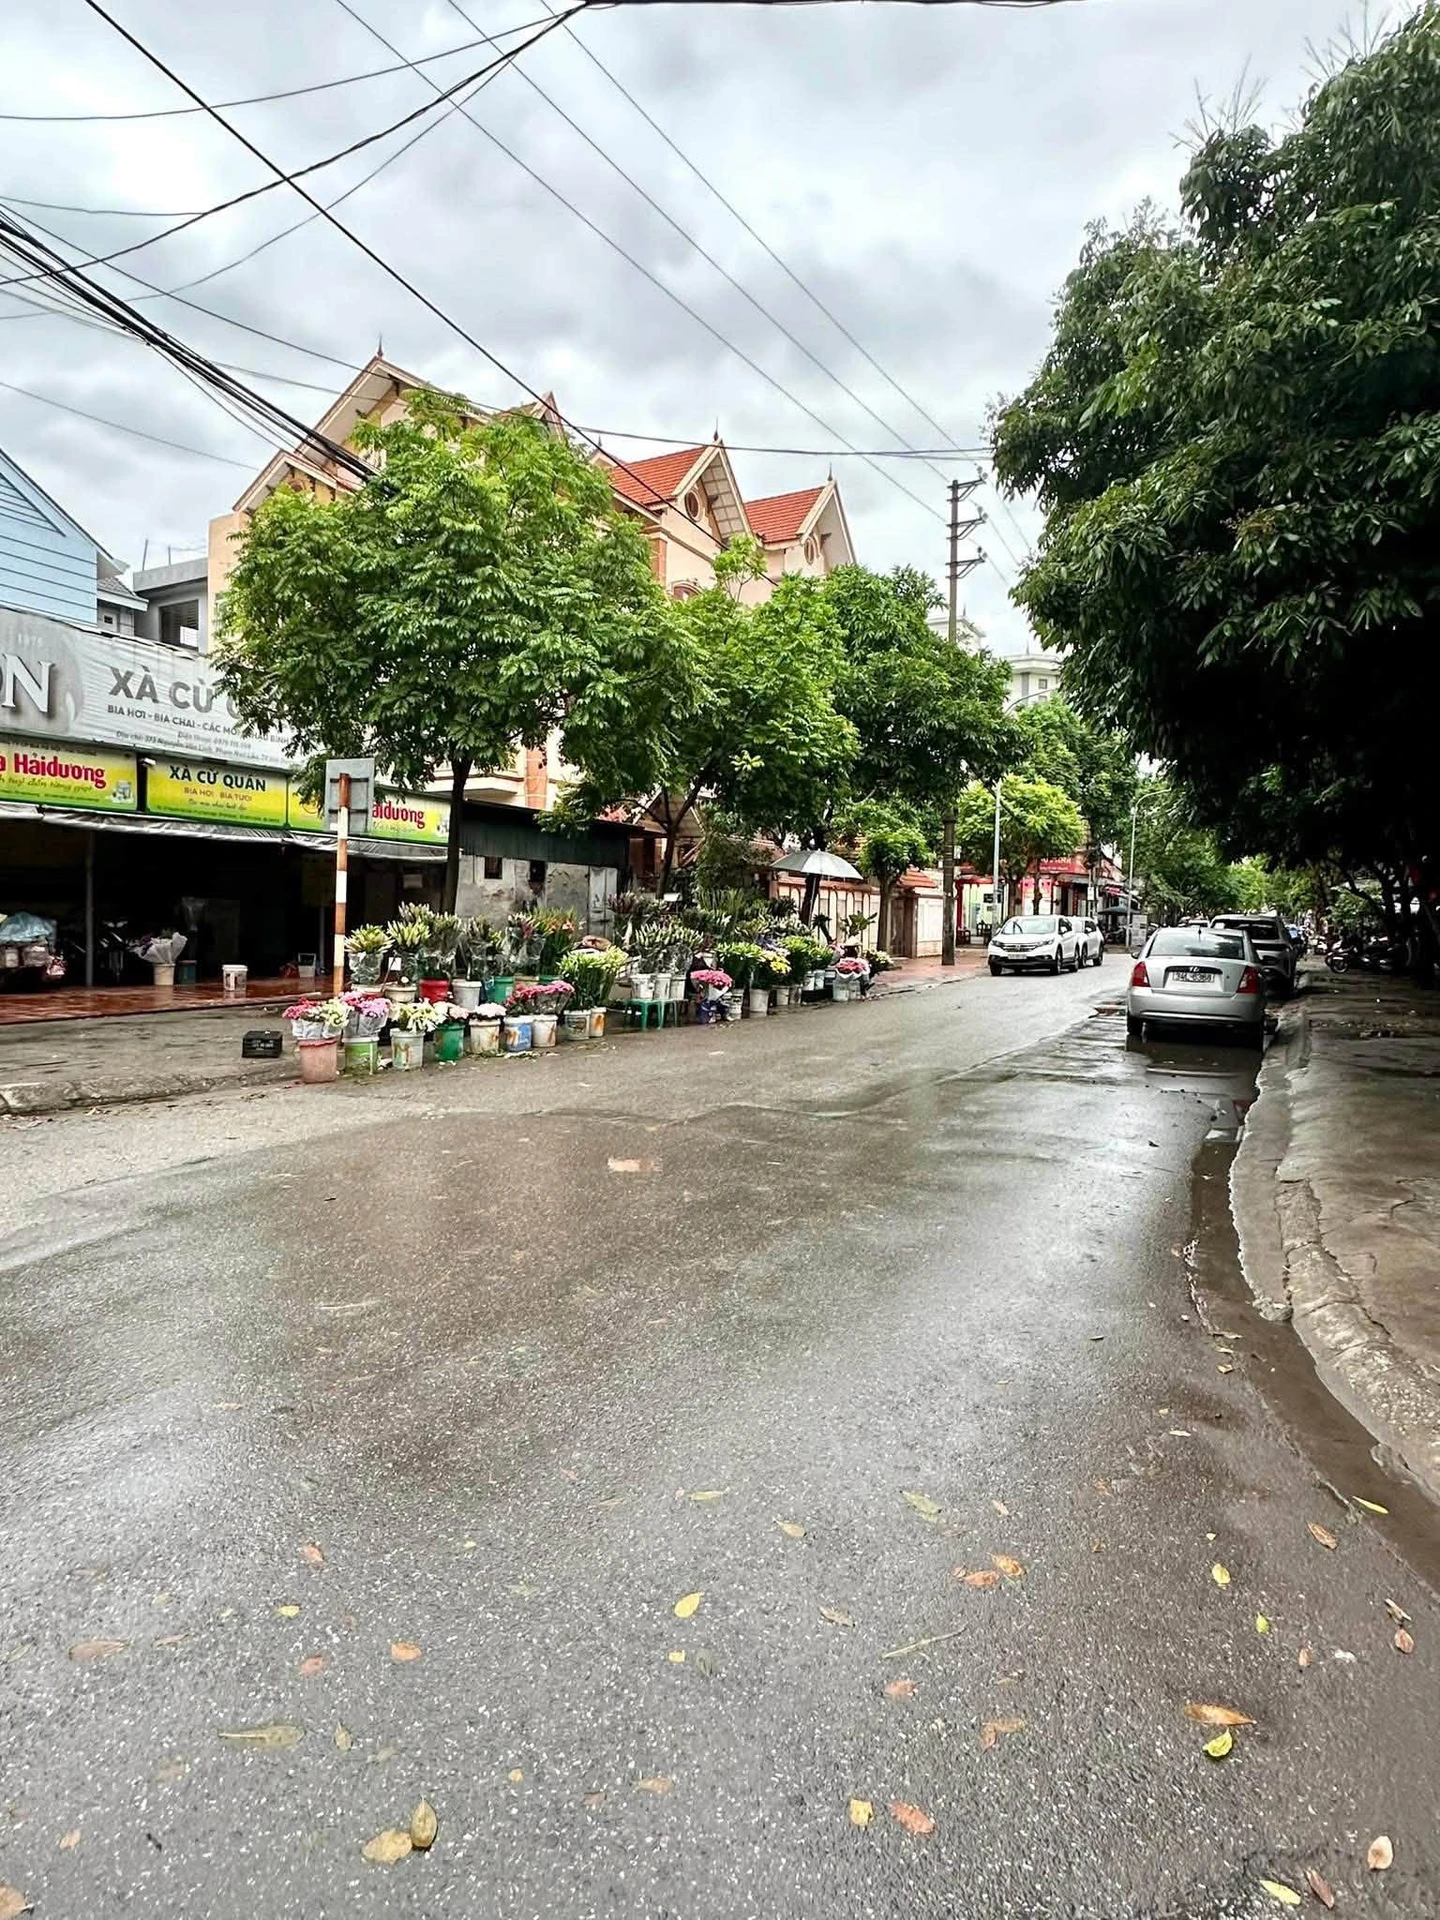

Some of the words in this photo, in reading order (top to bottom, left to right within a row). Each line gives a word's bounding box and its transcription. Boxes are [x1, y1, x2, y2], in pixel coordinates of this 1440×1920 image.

[109, 664, 159, 704] XÀ
[107, 704, 125, 716] BIA
[154, 712, 170, 723] BIA
[172, 716, 195, 728] CHAI
[169, 765, 192, 782] XÀ
[223, 774, 266, 792] QUÁN
